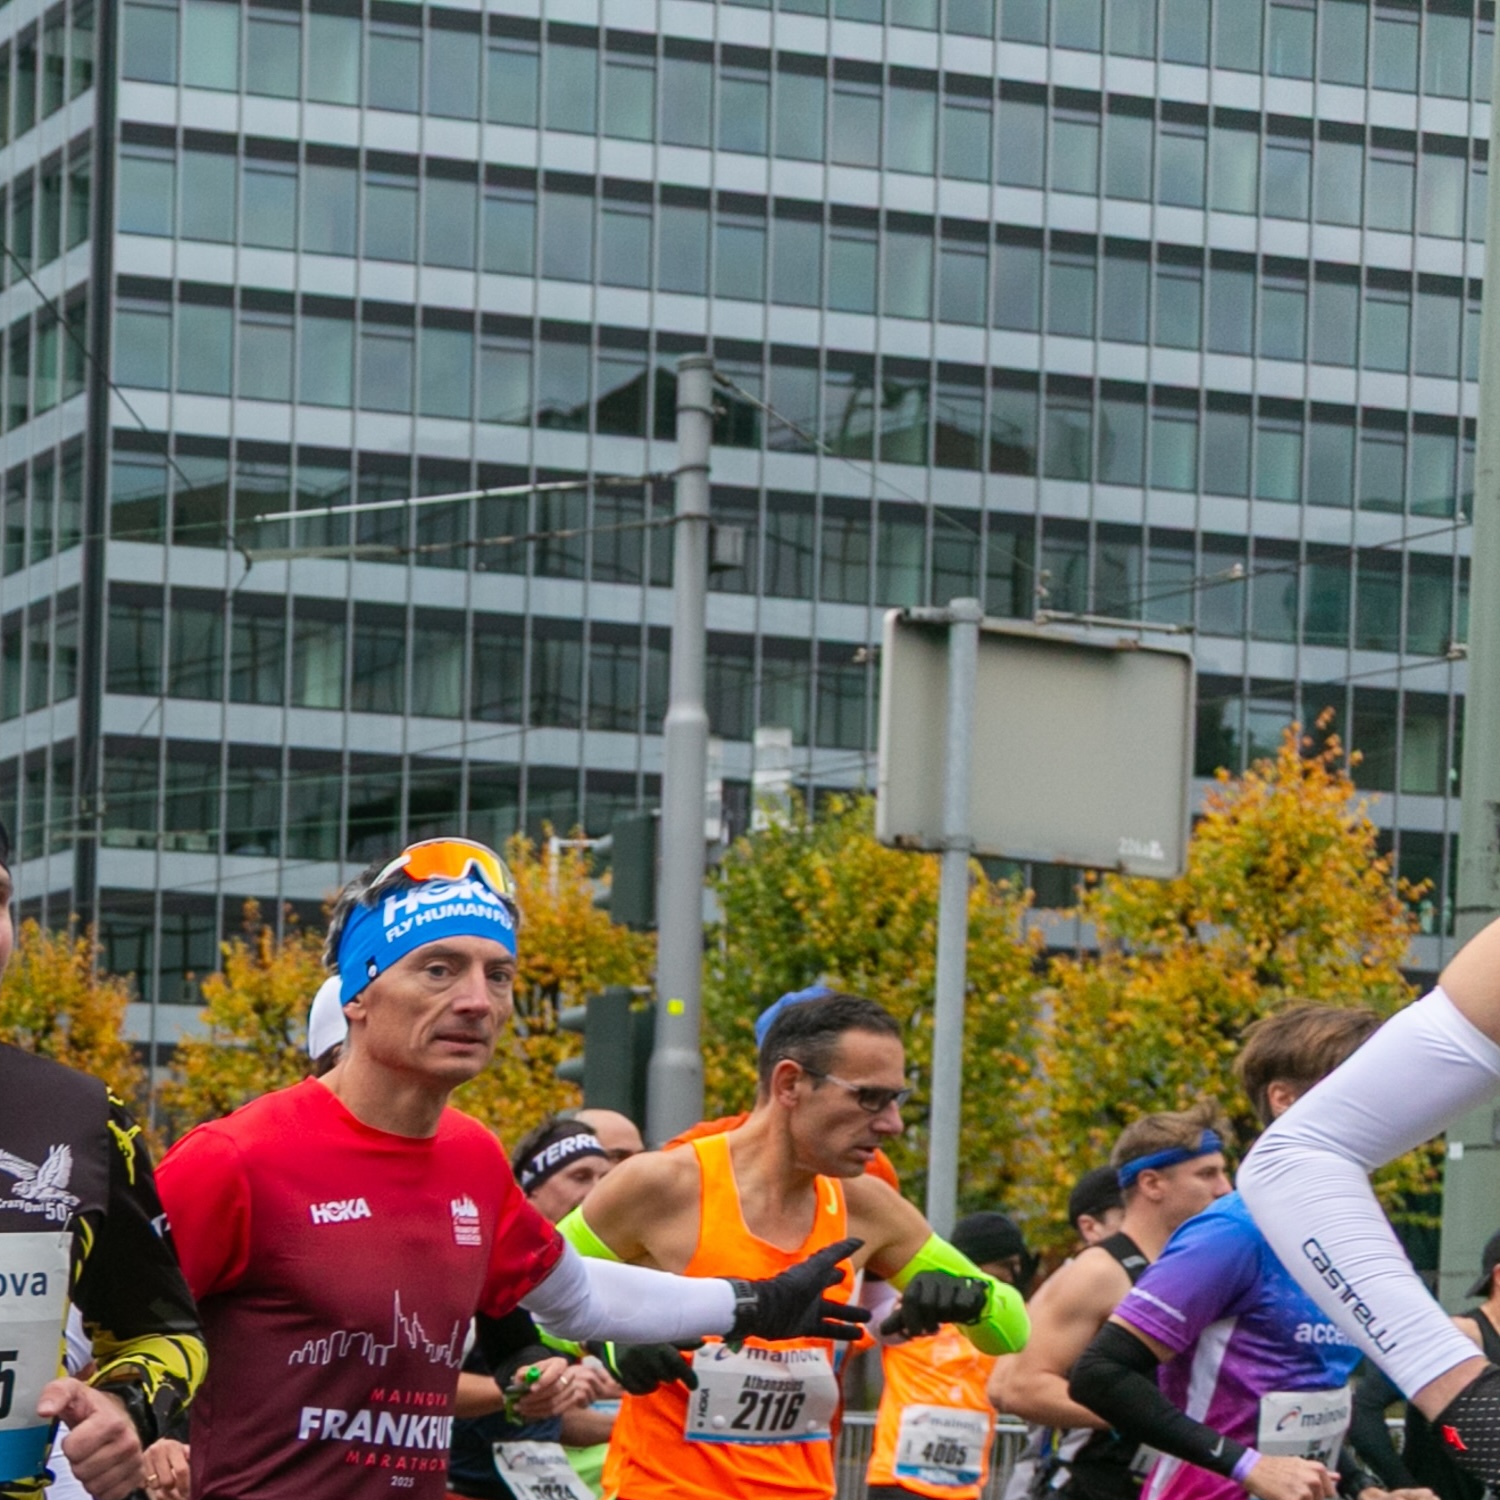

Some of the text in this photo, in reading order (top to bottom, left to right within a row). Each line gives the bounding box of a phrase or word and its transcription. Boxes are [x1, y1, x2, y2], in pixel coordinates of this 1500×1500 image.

[385, 917, 414, 943] FLY
[415, 903, 492, 926] HUMAN
[45, 1202, 67, 1221] 50
[309, 1197, 372, 1226] HOKA
[730, 1391, 806, 1431] 2116
[390, 1475, 415, 1488] 2025
